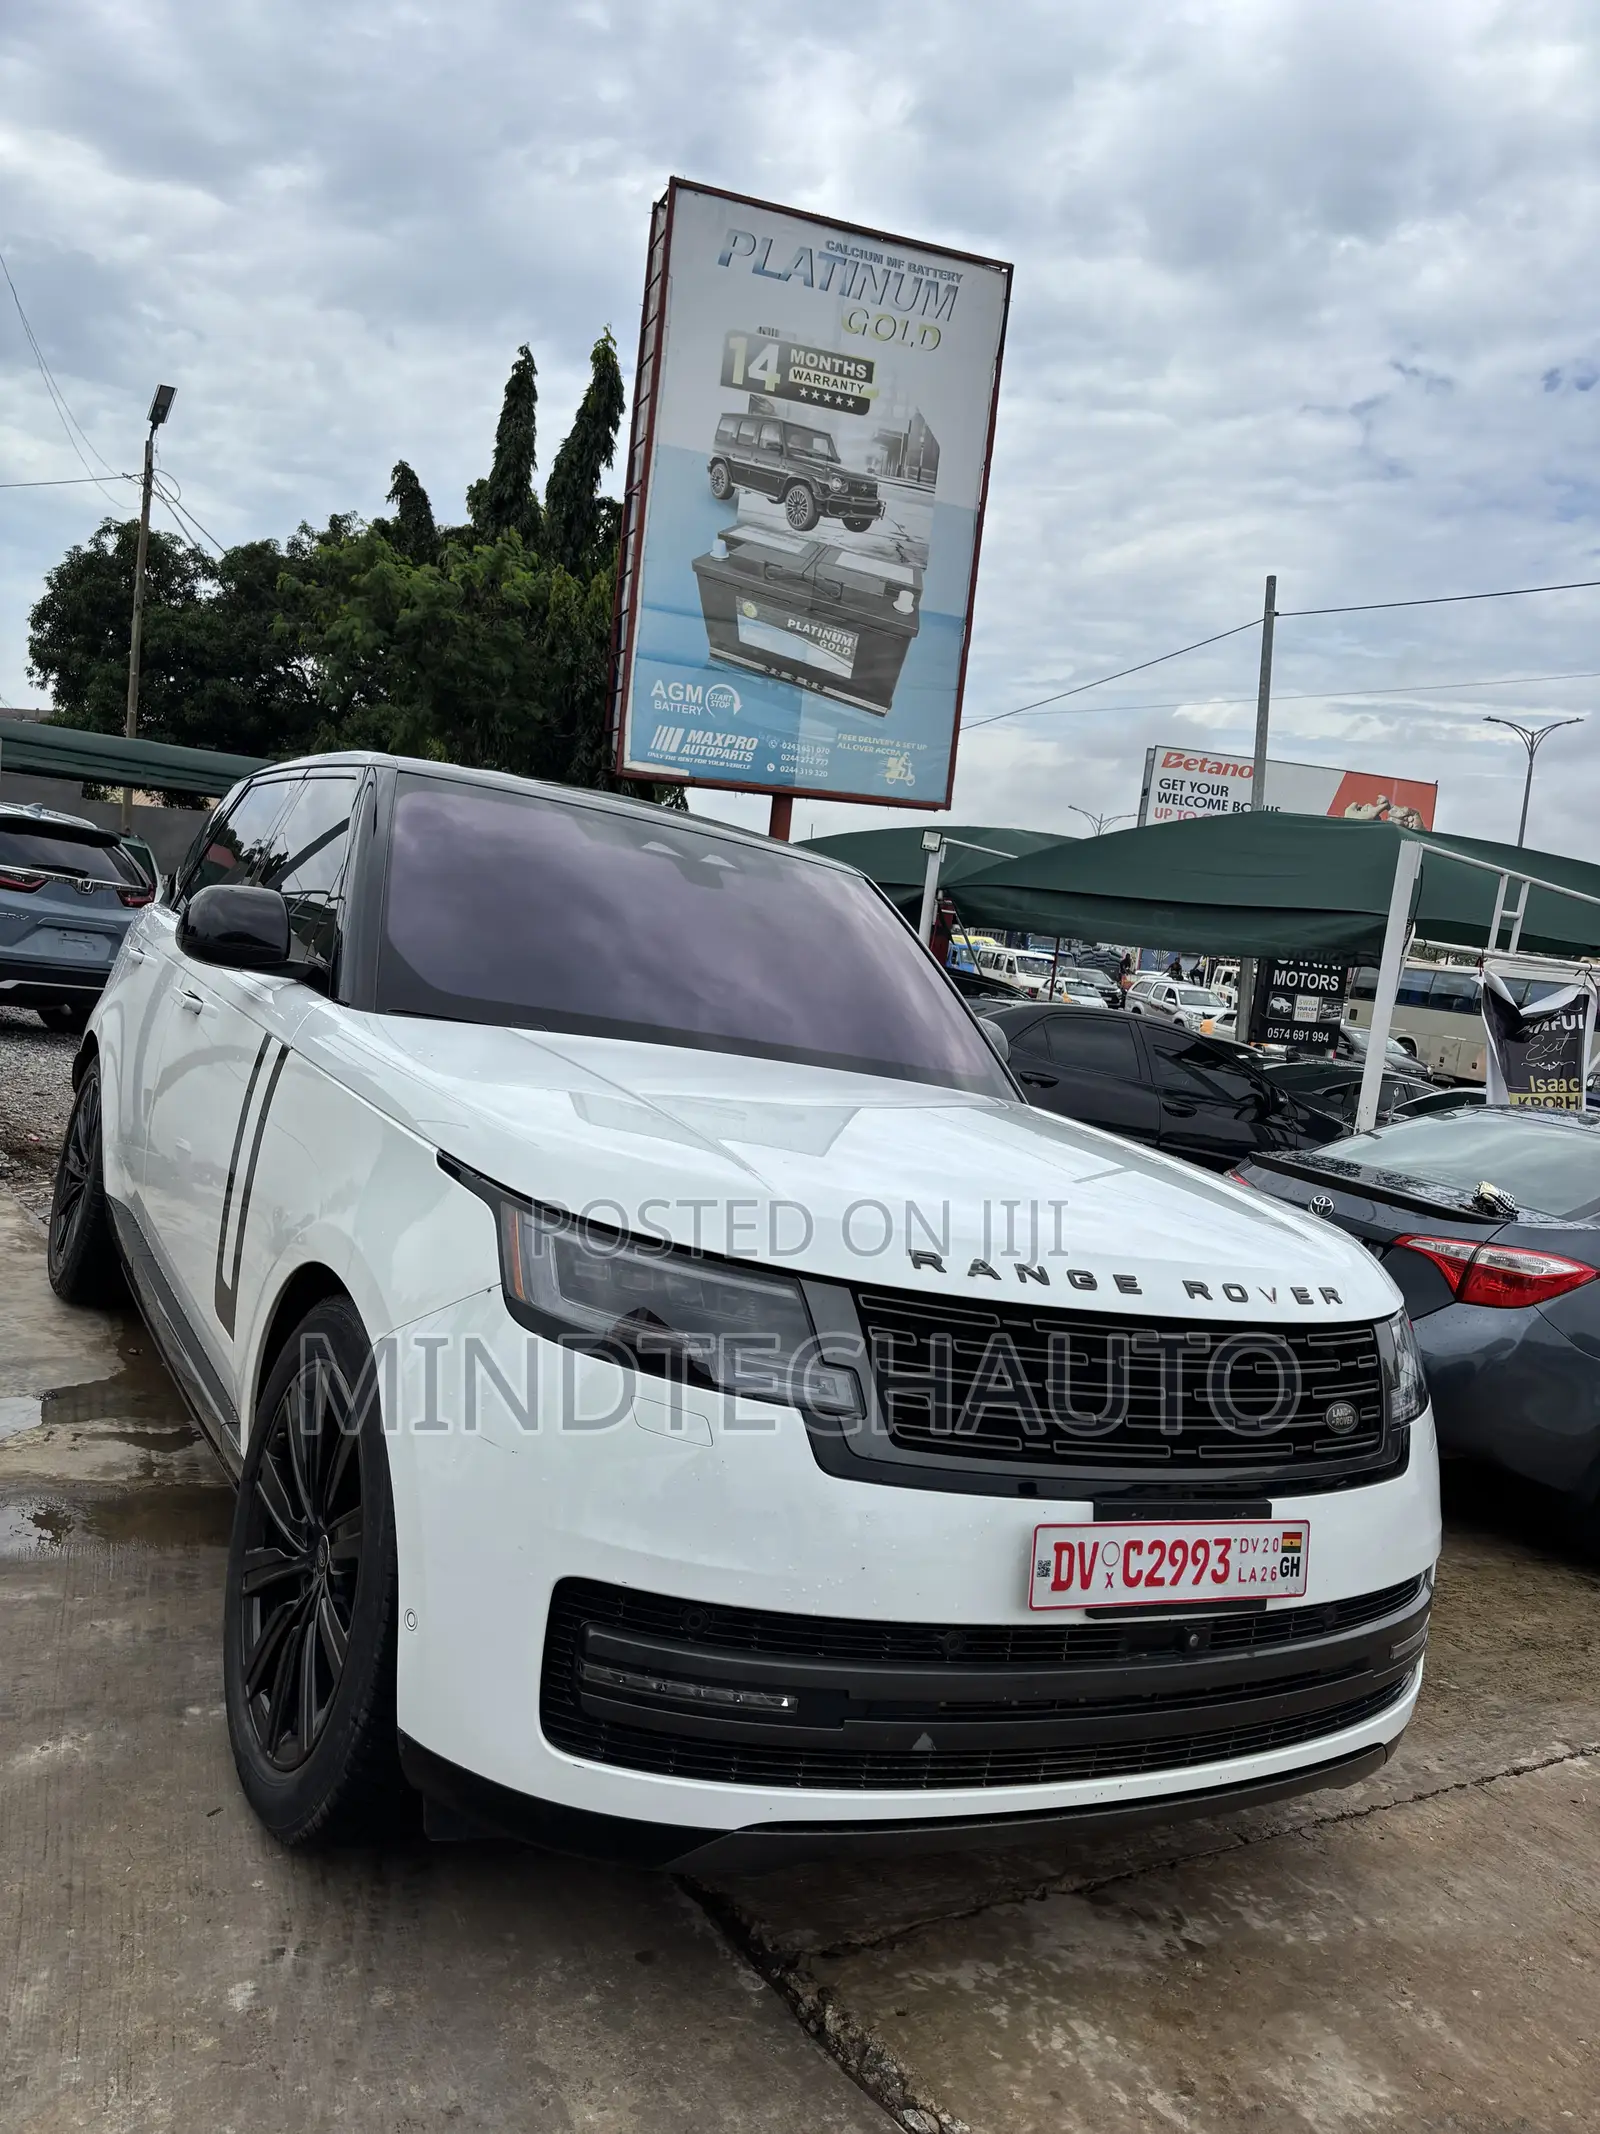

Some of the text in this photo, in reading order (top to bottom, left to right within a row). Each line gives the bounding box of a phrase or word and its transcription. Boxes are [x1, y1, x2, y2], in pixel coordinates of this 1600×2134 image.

[825, 240, 964, 283] CALCIUM MF BATTERY
[717, 228, 959, 322] PLATINUM
[841, 307, 942, 351] GOLD
[728, 336, 781, 392] 14
[790, 349, 867, 379] MONTHS
[793, 368, 865, 394] WARRANTY
[787, 618, 854, 648] PLATINUM
[819, 639, 852, 656] GOLD
[650, 680, 704, 704] AGM
[709, 692, 733, 702] START
[654, 699, 704, 716] BATTERY
[710, 700, 731, 709] STOP
[686, 729, 758, 751] MAXPRO
[837, 733, 857, 742] FREE
[858, 735, 896, 747] DELIVERY
[902, 741, 916, 749] SET
[837, 742, 901, 757] ALL OVER ACCRA
[680, 744, 754, 762] AUTOPARTS
[780, 765, 829, 778] 0244 319 320
[1161, 751, 1254, 778] Betano
[1159, 777, 1229, 797] GET YOUR
[1157, 791, 1229, 812] WELCOME
[1153, 807, 1173, 820] UP
[1177, 809, 1197, 820] TO
[1273, 969, 1340, 991] MOTORS
[1267, 1027, 1329, 1042] 0574 691 994
[1525, 1032, 1577, 1061] Exit
[1529, 1075, 1580, 1093] Isaac
[908, 1248, 1343, 1305] RANGE ROVER
[1051, 1541, 1099, 1592] DV
[1122, 1538, 1232, 1588] C2993
[1280, 1556, 1300, 1578] GH
